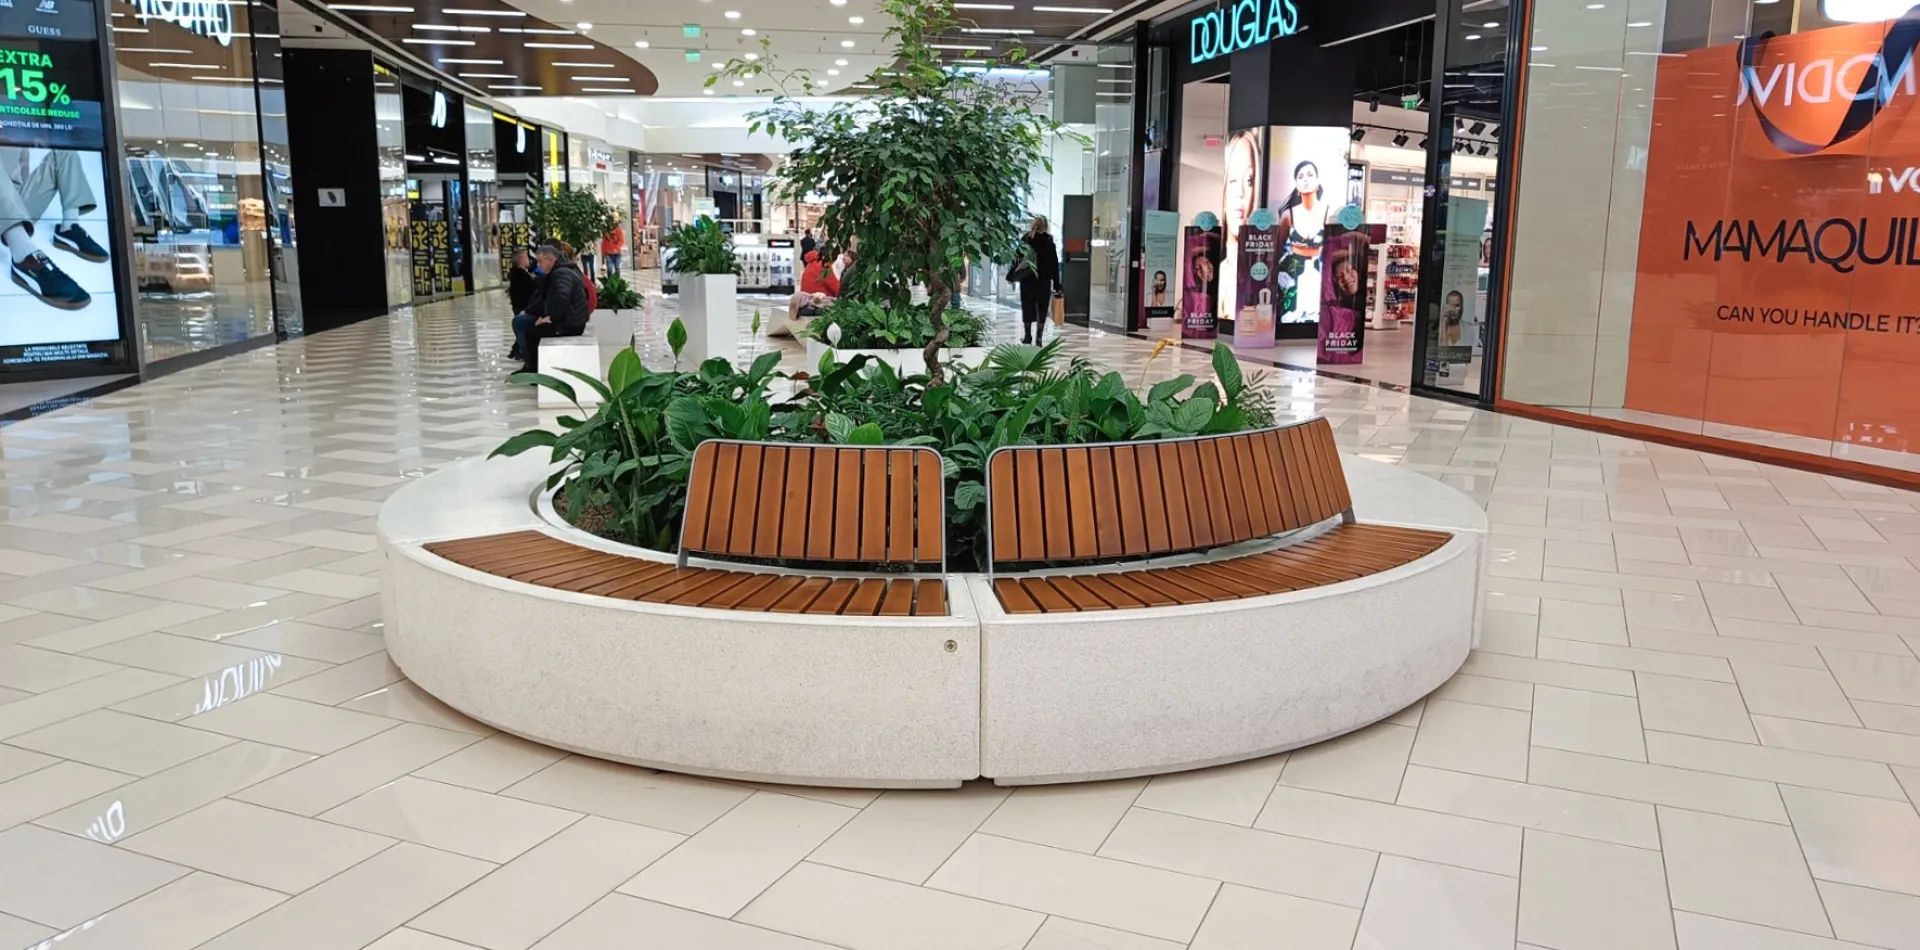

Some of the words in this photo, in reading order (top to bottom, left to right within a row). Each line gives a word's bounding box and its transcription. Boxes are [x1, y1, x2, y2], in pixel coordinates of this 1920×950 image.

[28, 24, 61, 37] GUESS
[1191, 0, 1298, 64] DOUGLAS
[48, 108, 80, 119] REDUSE
[1717, 305, 1754, 322] CAN
[1760, 307, 1798, 325] YOU
[1803, 310, 1890, 332] HANDLE
